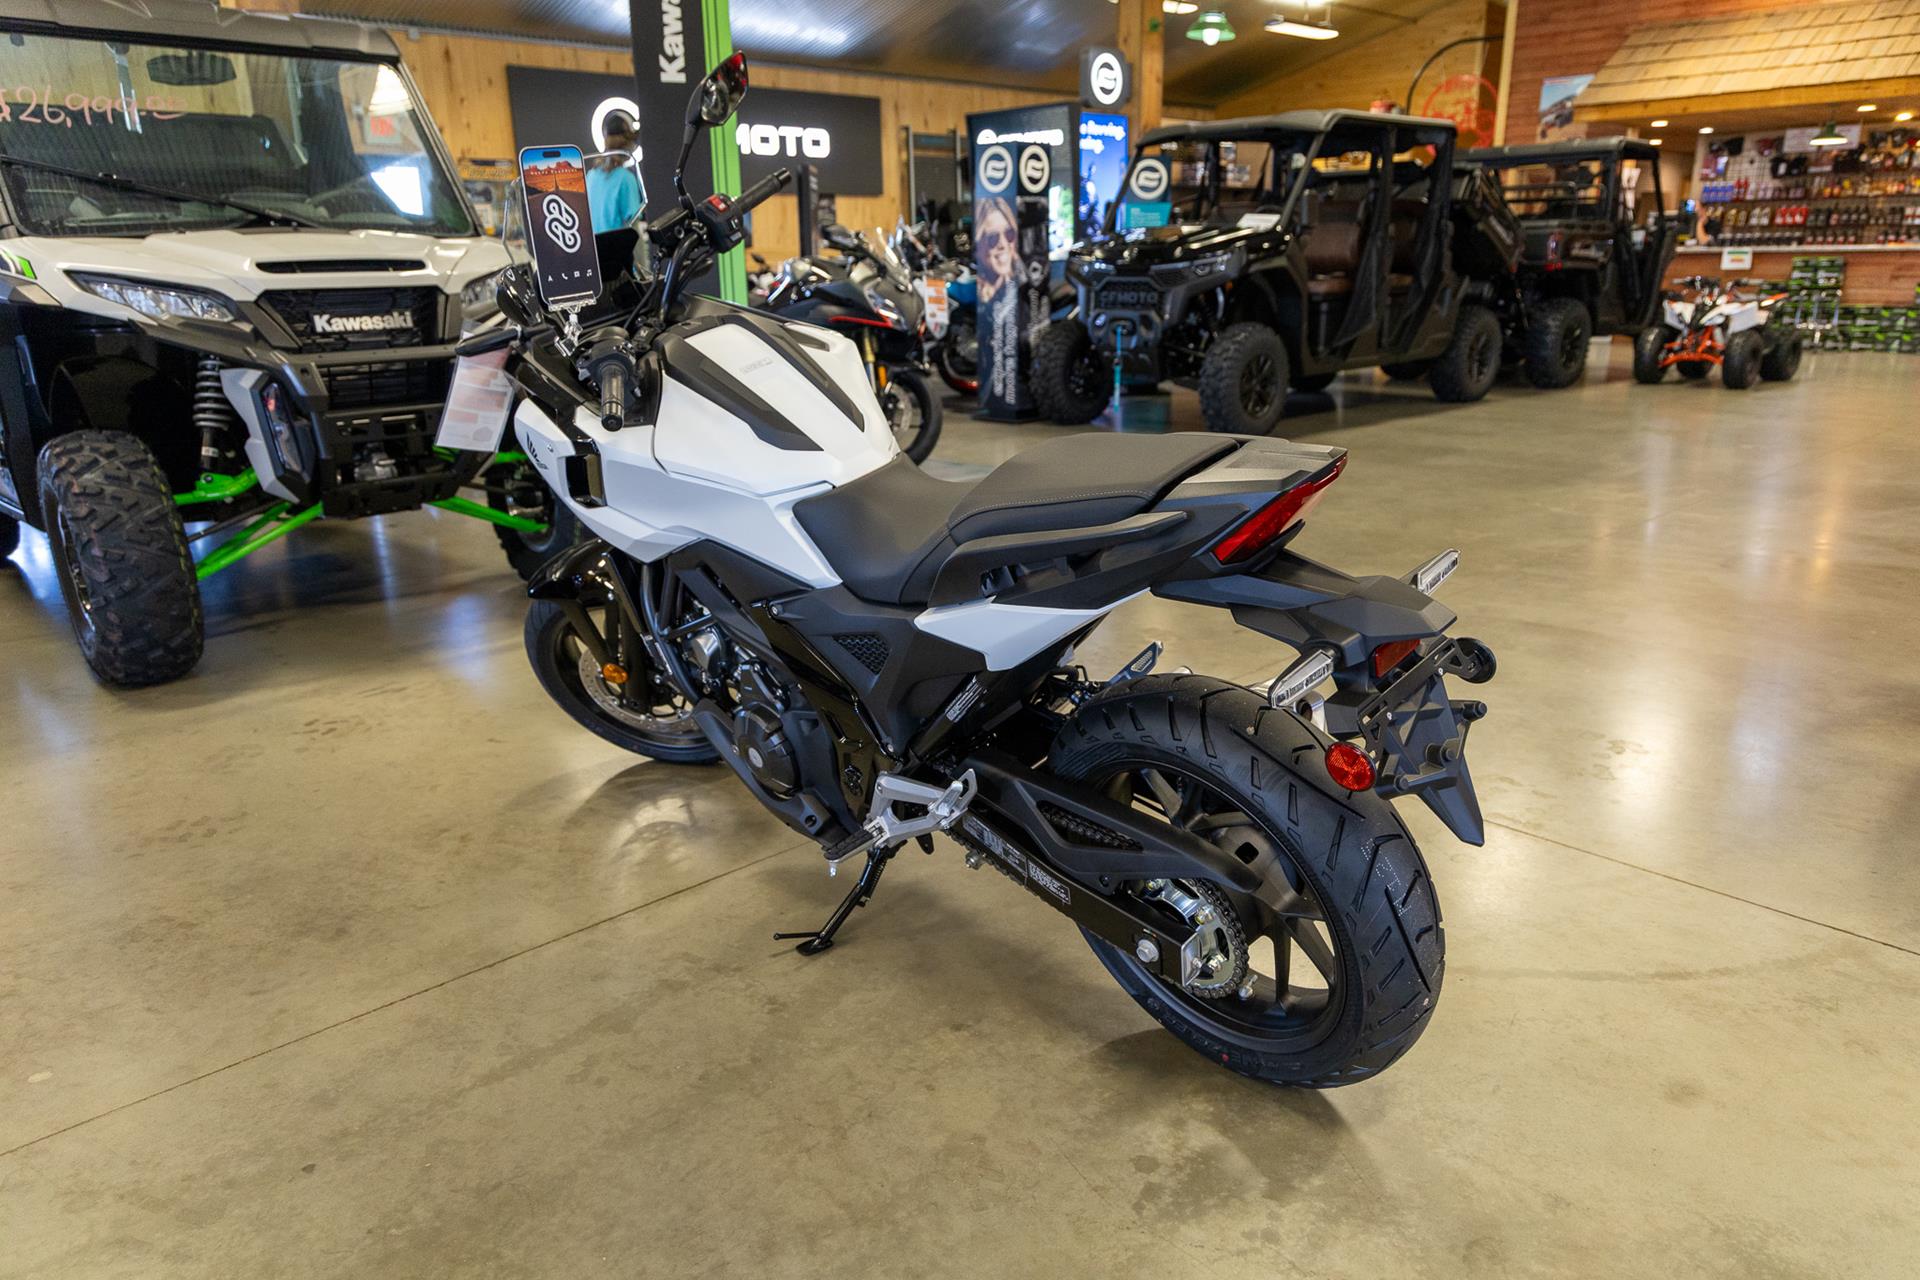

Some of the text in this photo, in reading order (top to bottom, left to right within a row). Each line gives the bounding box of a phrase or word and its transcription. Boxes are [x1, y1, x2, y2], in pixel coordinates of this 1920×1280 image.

[659, 0, 687, 83] Kaw
[1101, 291, 1158, 304] CFMOTO
[313, 311, 414, 333] Kawasaki
